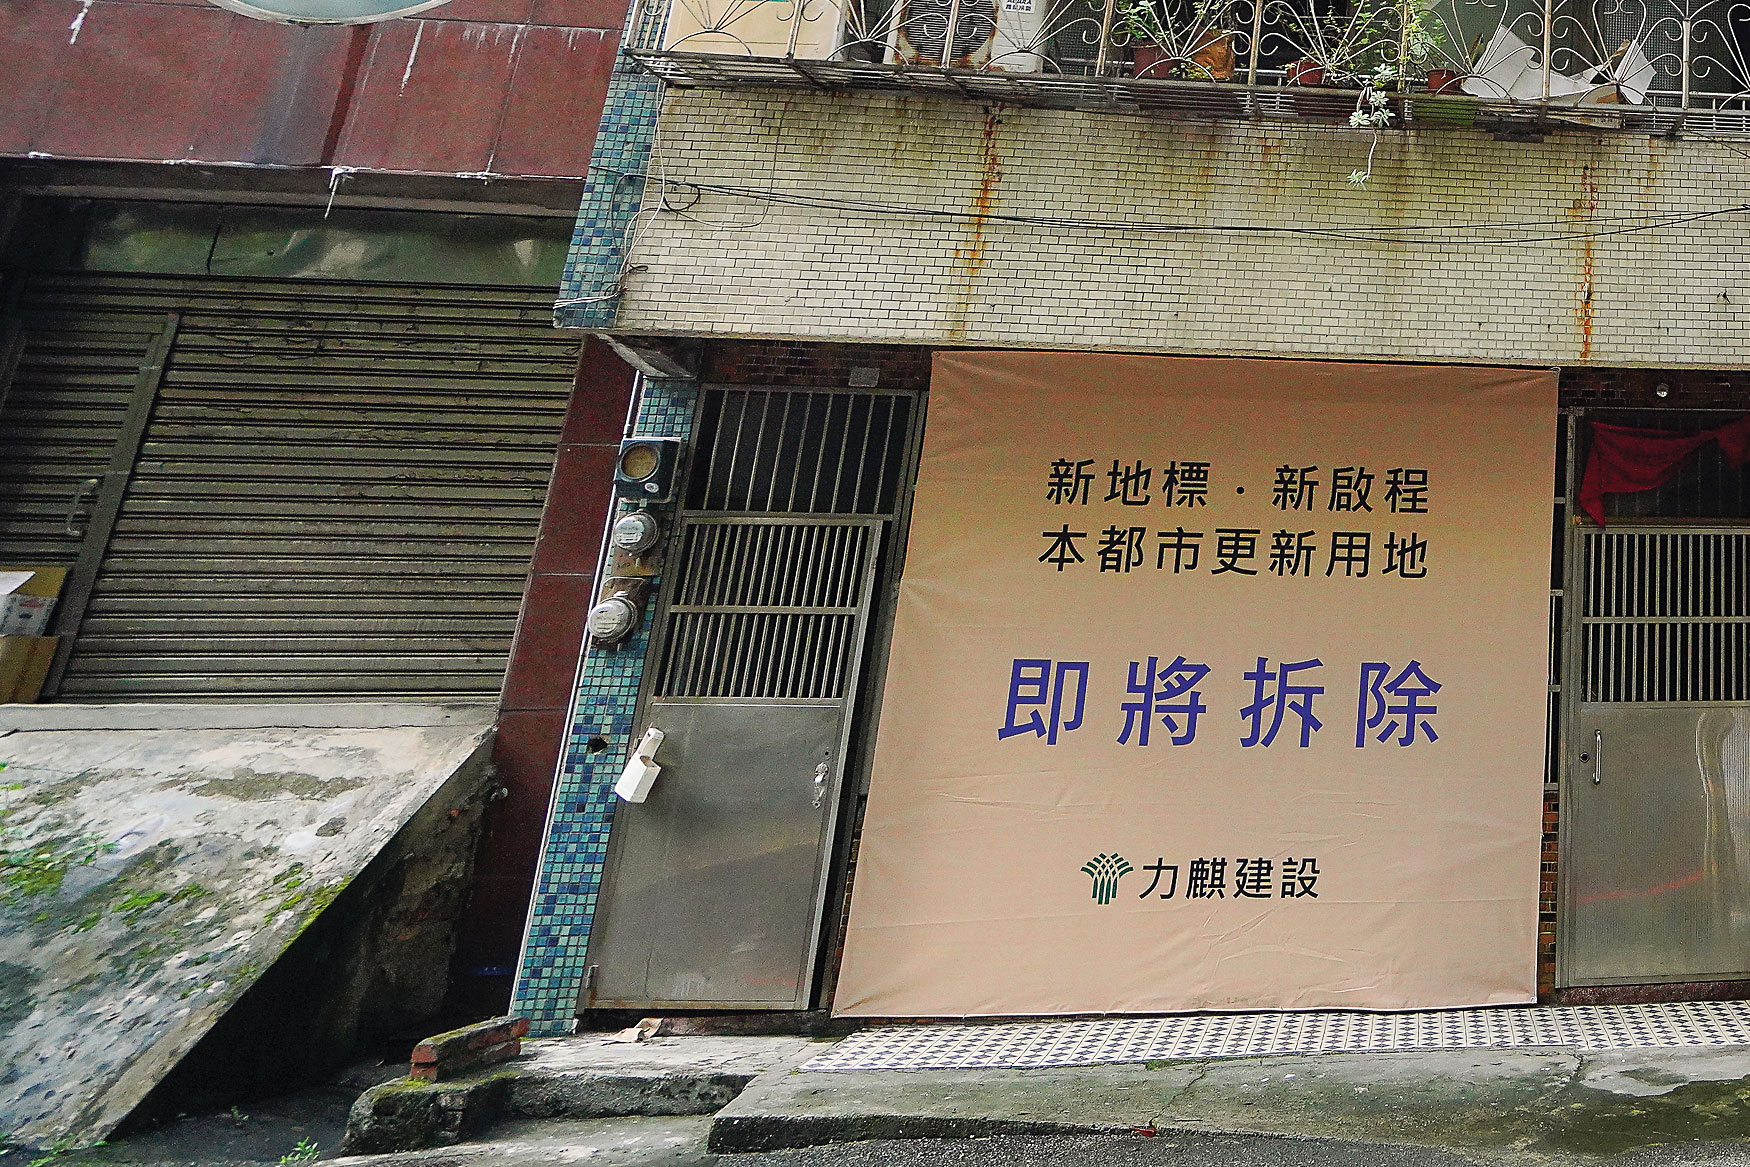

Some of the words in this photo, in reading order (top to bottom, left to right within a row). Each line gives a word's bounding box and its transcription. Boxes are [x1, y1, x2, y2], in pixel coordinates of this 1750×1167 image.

[1037, 523, 1429, 580] 本都市更新用地
[997, 656, 1442, 748] 即將拆除
[1138, 856, 1321, 900] 力麒建設
